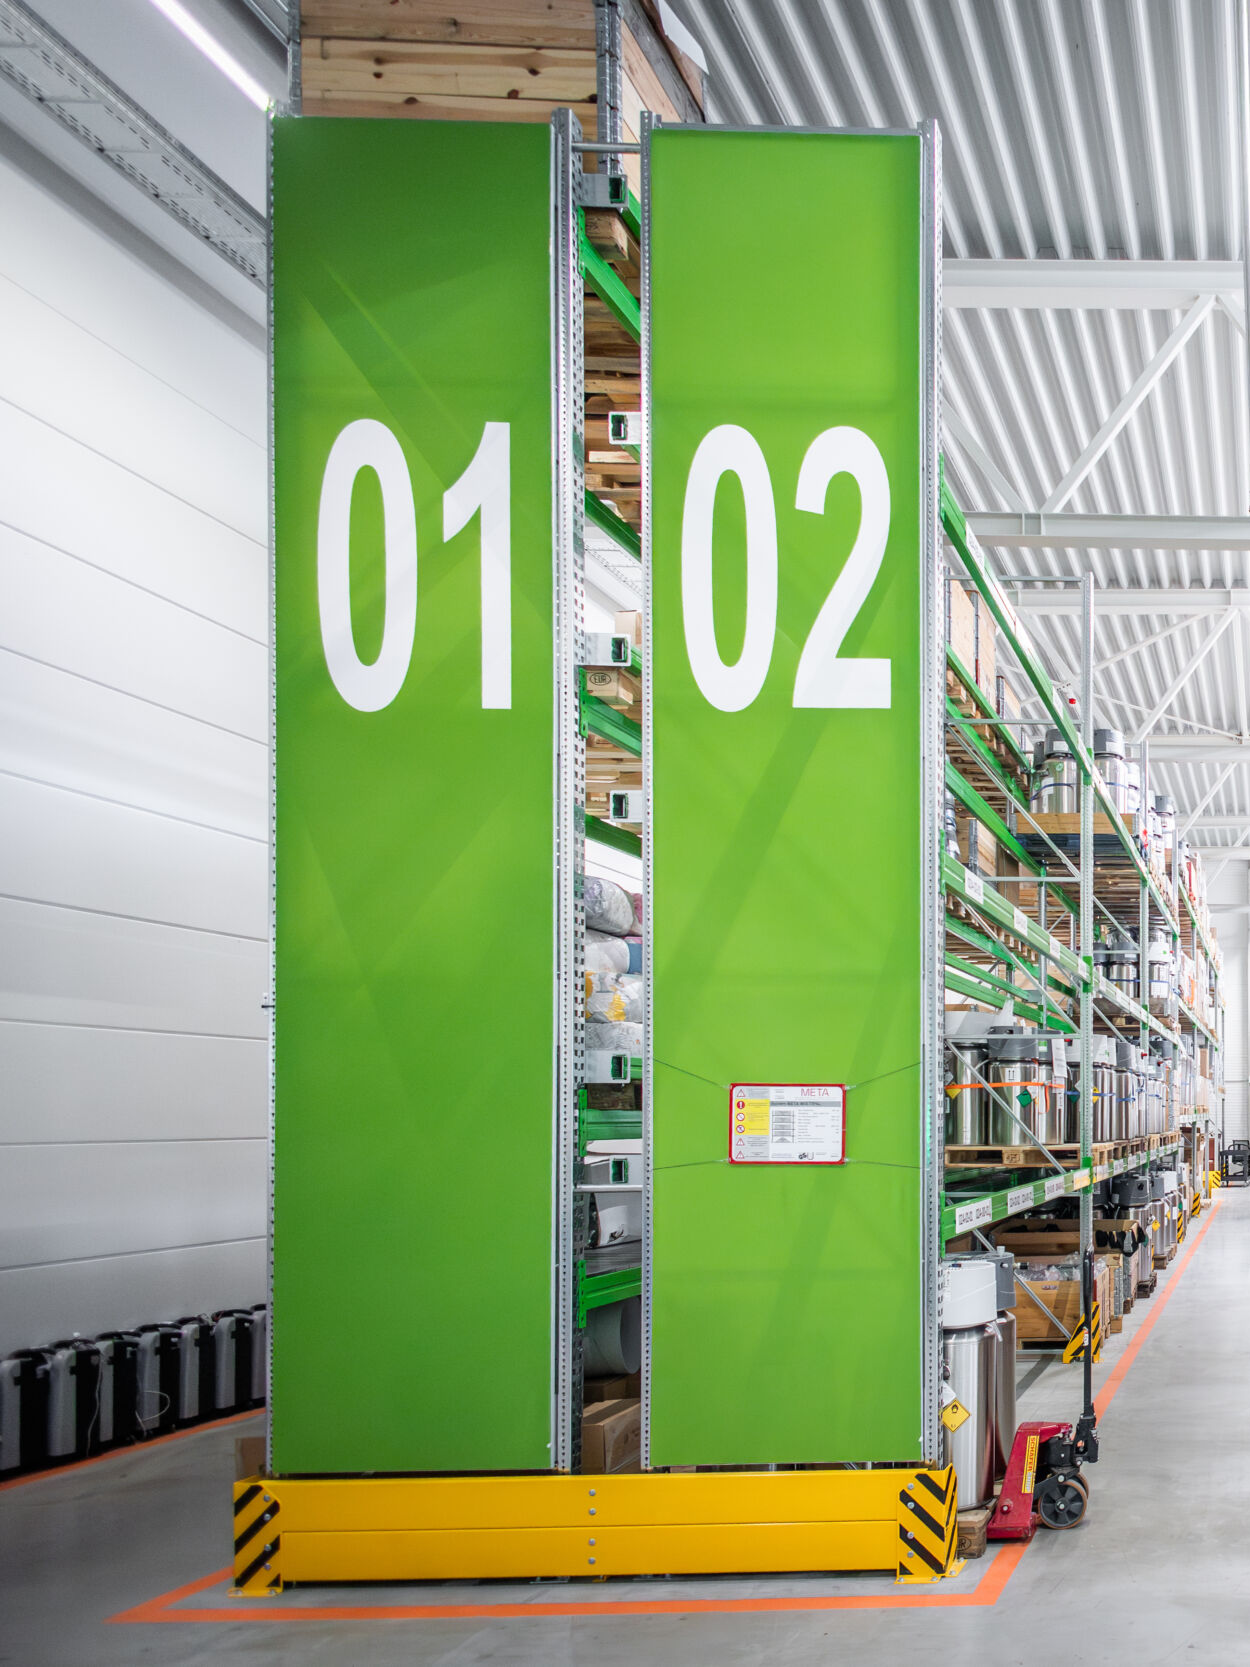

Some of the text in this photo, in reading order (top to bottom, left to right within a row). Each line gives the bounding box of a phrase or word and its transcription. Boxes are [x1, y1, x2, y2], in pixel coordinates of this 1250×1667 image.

[317, 419, 511, 712] 01
[681, 424, 892, 713] 02
[800, 1088, 830, 1097] META
